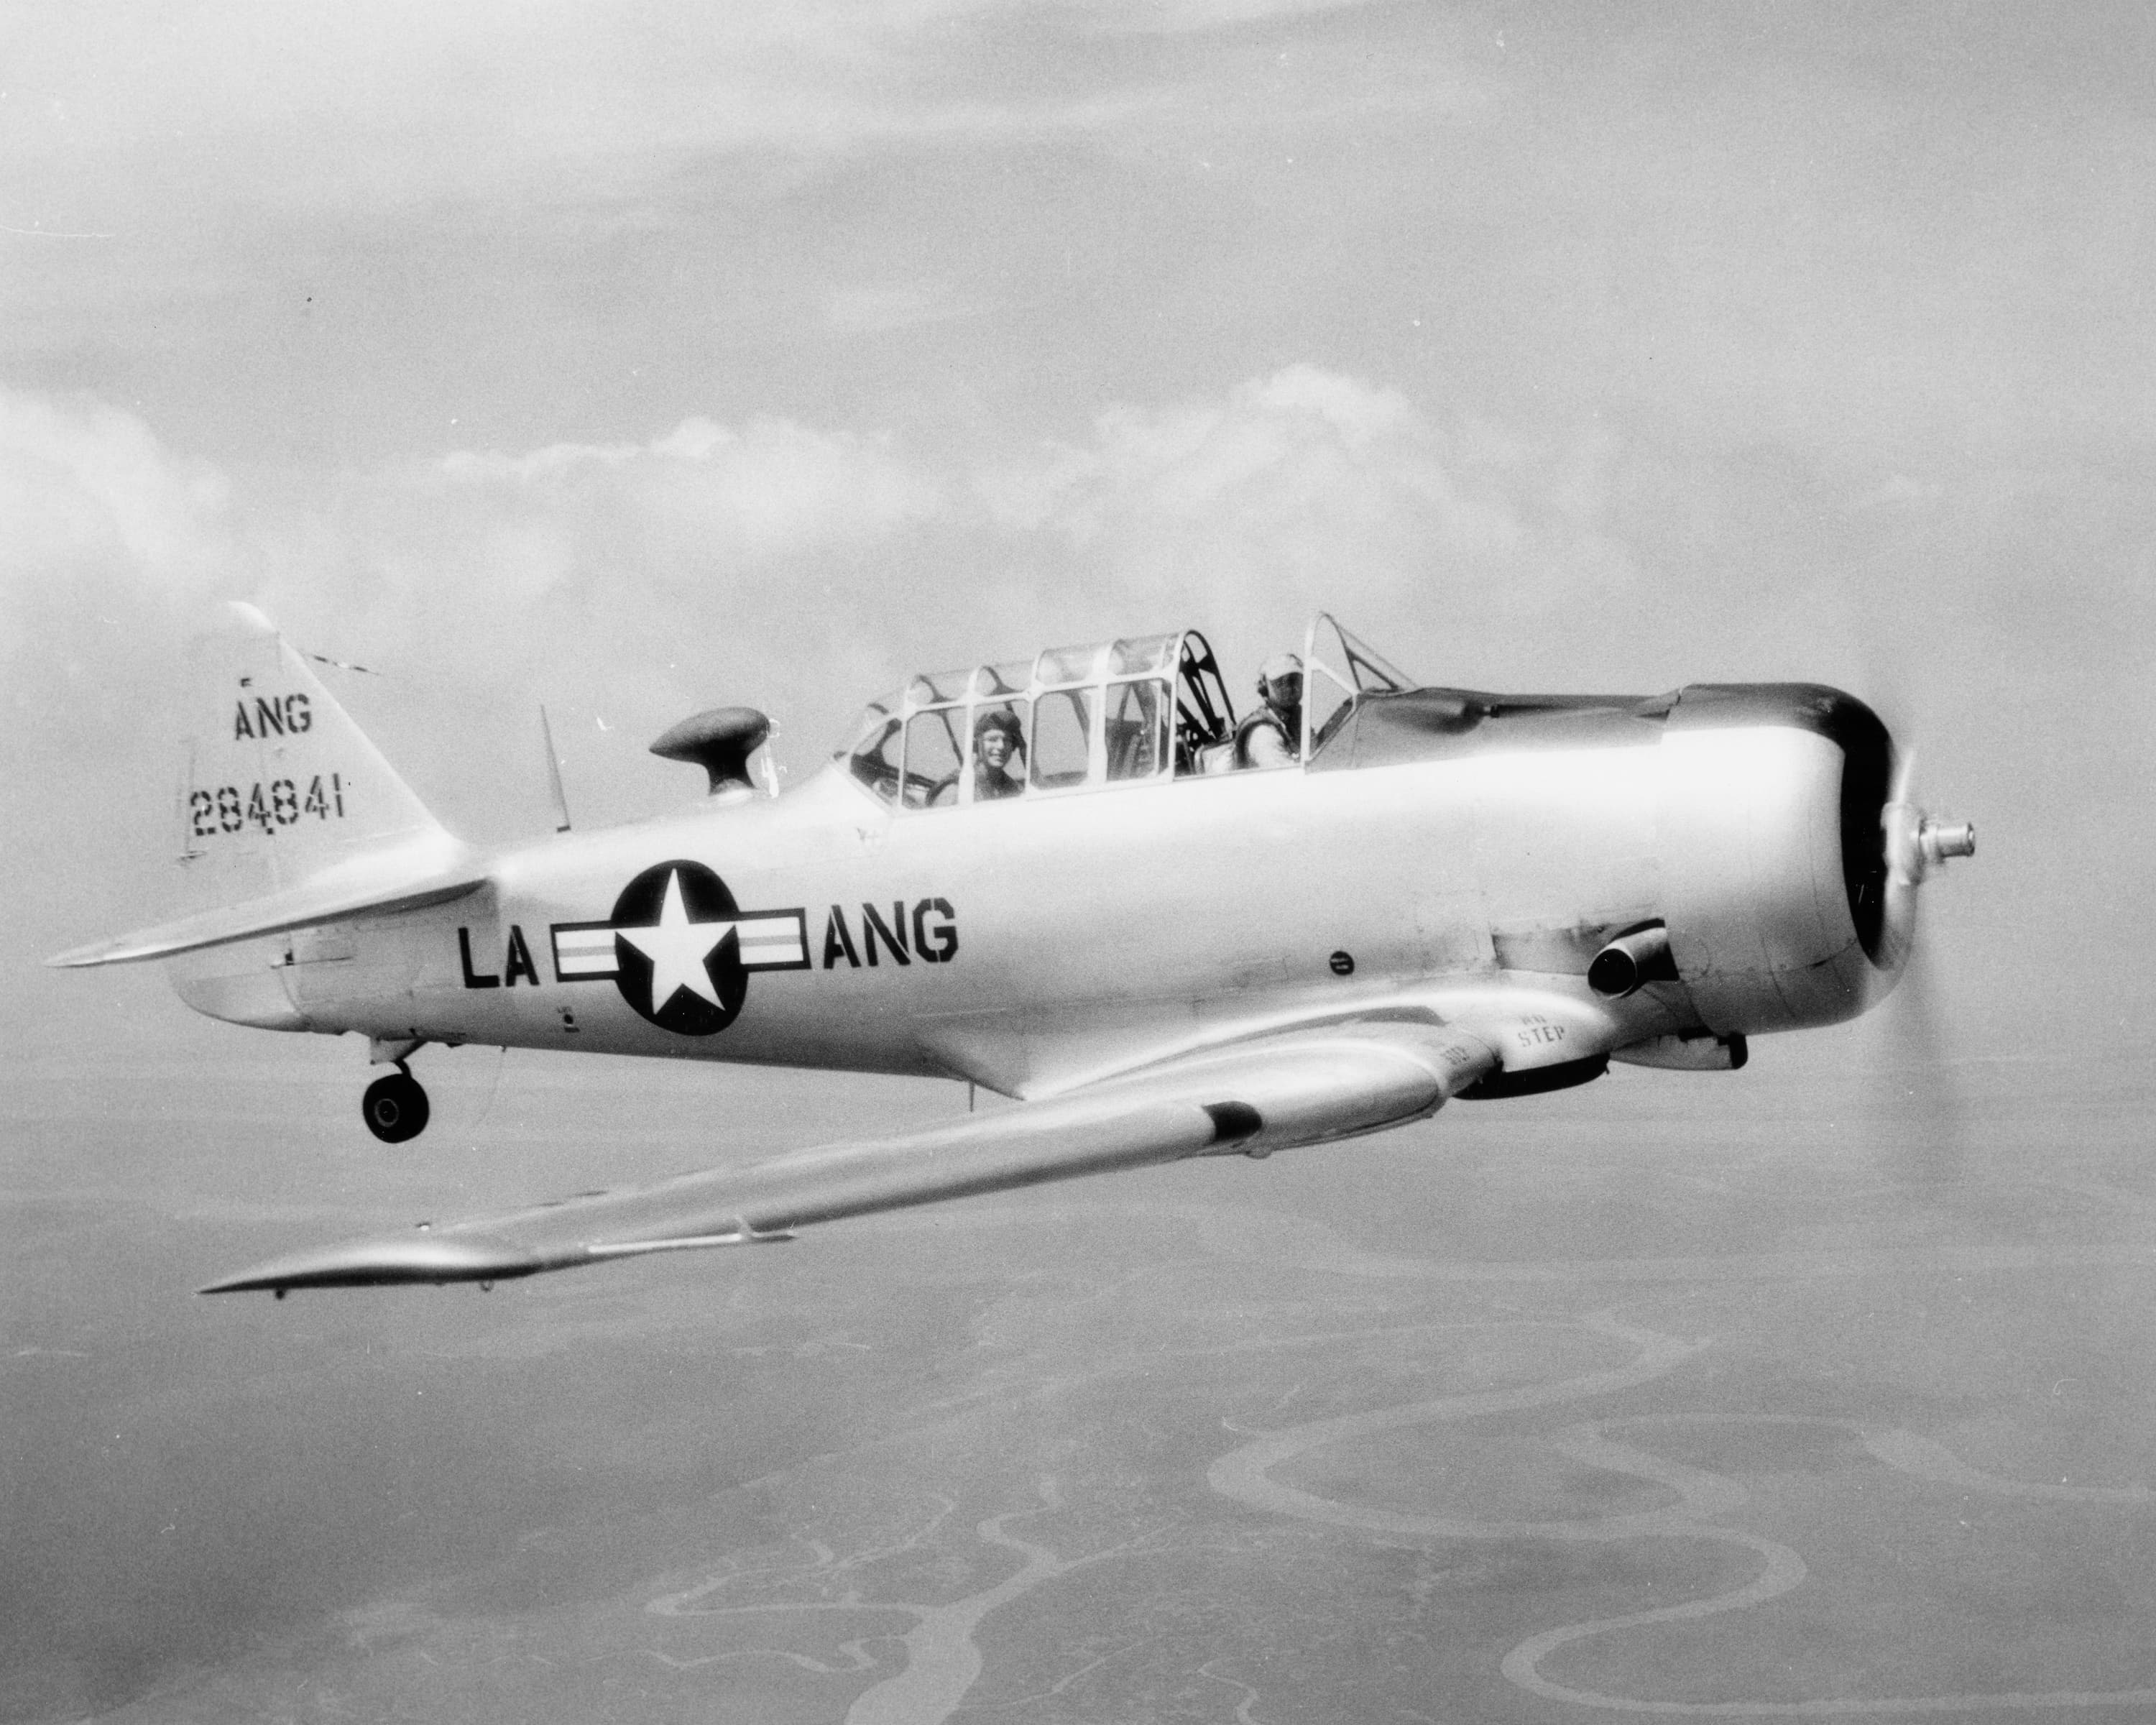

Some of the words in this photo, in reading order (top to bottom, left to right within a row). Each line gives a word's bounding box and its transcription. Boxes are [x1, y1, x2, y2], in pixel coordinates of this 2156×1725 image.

[235, 693, 311, 741] ANG
[190, 773, 344, 837] 284841
[458, 924, 540, 989] LA
[823, 897, 959, 970] ANG
[1517, 1025, 1565, 1048] STEP
